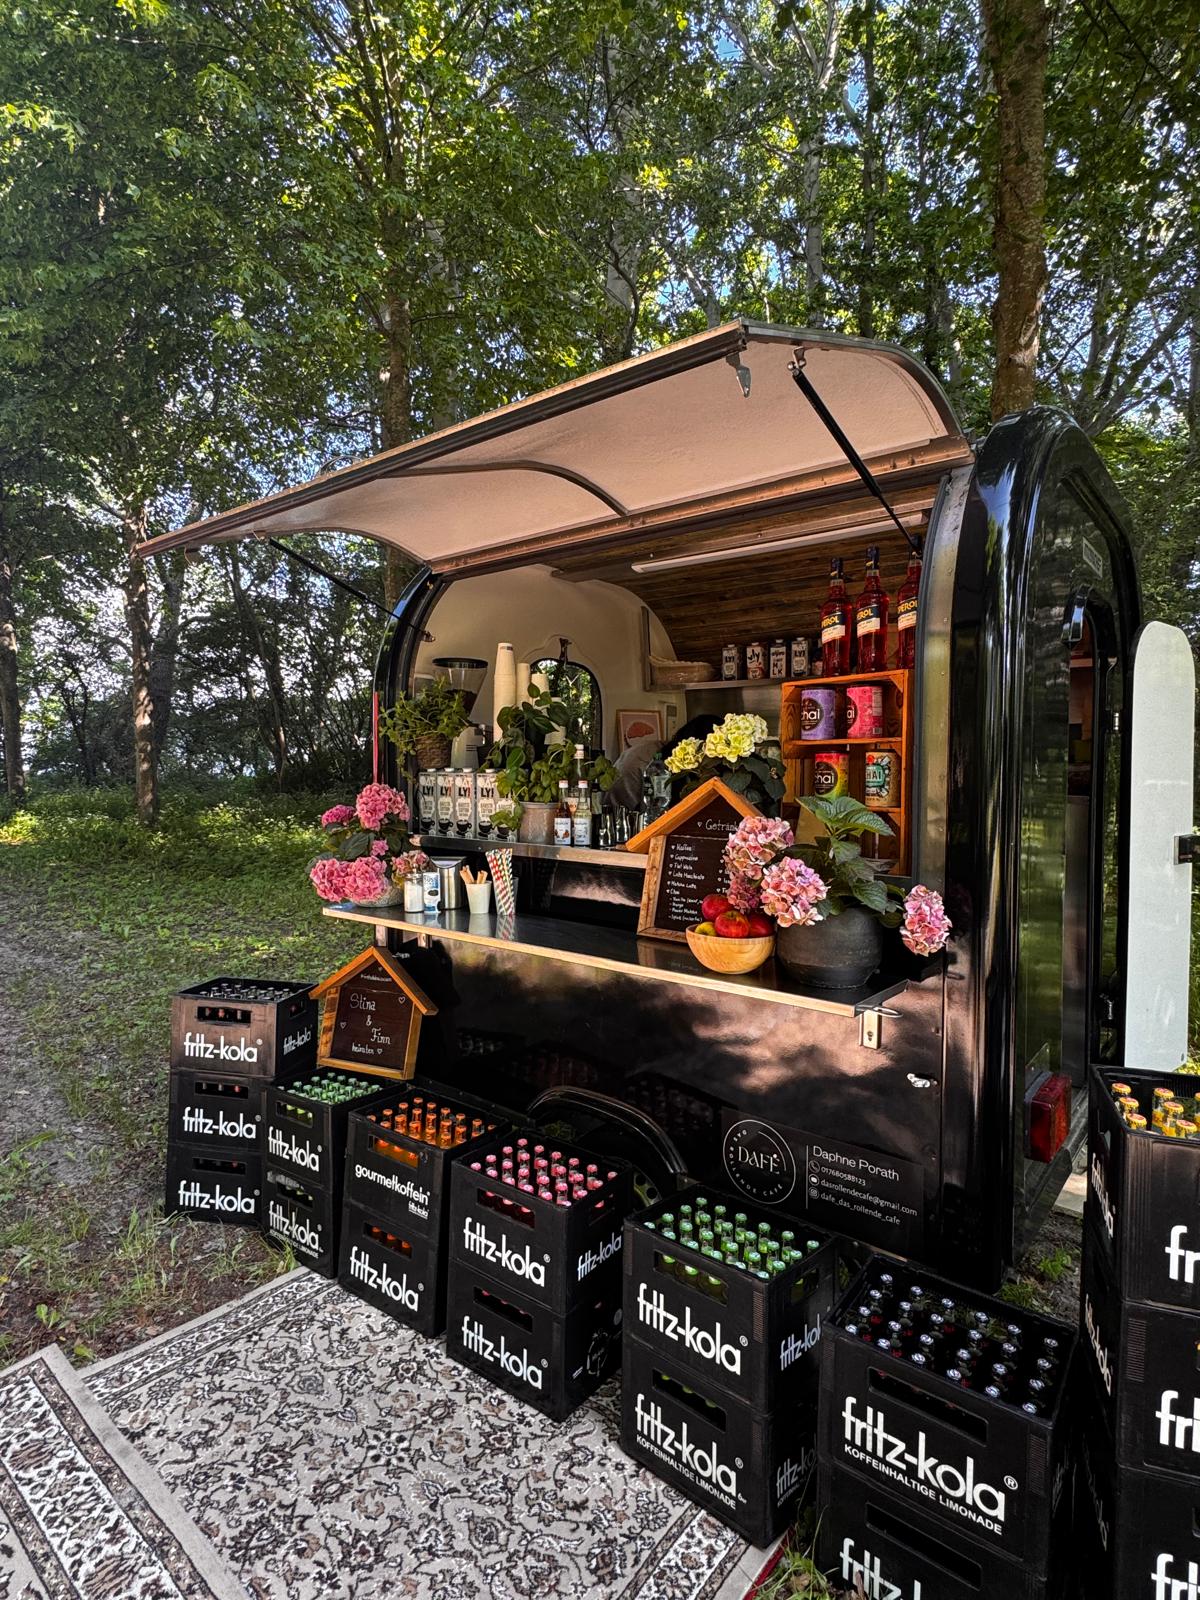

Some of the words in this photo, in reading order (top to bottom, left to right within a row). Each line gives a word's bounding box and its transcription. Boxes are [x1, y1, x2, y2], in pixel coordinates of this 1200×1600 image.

[422, 786, 434, 795] LY!
[440, 786, 452, 796] LY!
[458, 787, 470, 797] LY!
[481, 787, 494, 798] LY!
[350, 993, 376, 1011] Stina
[365, 1014, 372, 1026] &
[183, 1031, 258, 1062] fritz-kola
[283, 1027, 312, 1055] fritz-kola
[370, 1027, 391, 1045] Finn
[182, 1106, 257, 1139] fritz-kola
[268, 1126, 320, 1172] fritz-kola
[812, 1145, 857, 1168] Daphne
[858, 1159, 900, 1182] Porath
[178, 1179, 256, 1214] fritz-kola
[355, 1164, 429, 1206] gourmetkoffein
[820, 1179, 918, 1216] dasrollendecafe@gmail.com
[268, 1200, 319, 1251] fritz-kola
[820, 1192, 901, 1225] dafe_das_rollende_cafe
[463, 1217, 546, 1287] fritz-kola
[577, 1232, 622, 1281] fritz-kola
[350, 1245, 419, 1312] fritz-kola
[637, 1283, 741, 1376] fritz-kola
[462, 1315, 543, 1390] fritz-kola
[635, 1393, 737, 1498] fritz-kola
[842, 1396, 1006, 1522] fritz-kola
[636, 1434, 695, 1481] KOFFEINHALTIGE
[695, 1475, 737, 1511] LIMONADE
[844, 1443, 937, 1500] KOFFEINHALTIGE
[939, 1494, 1003, 1537] LIMONADE
